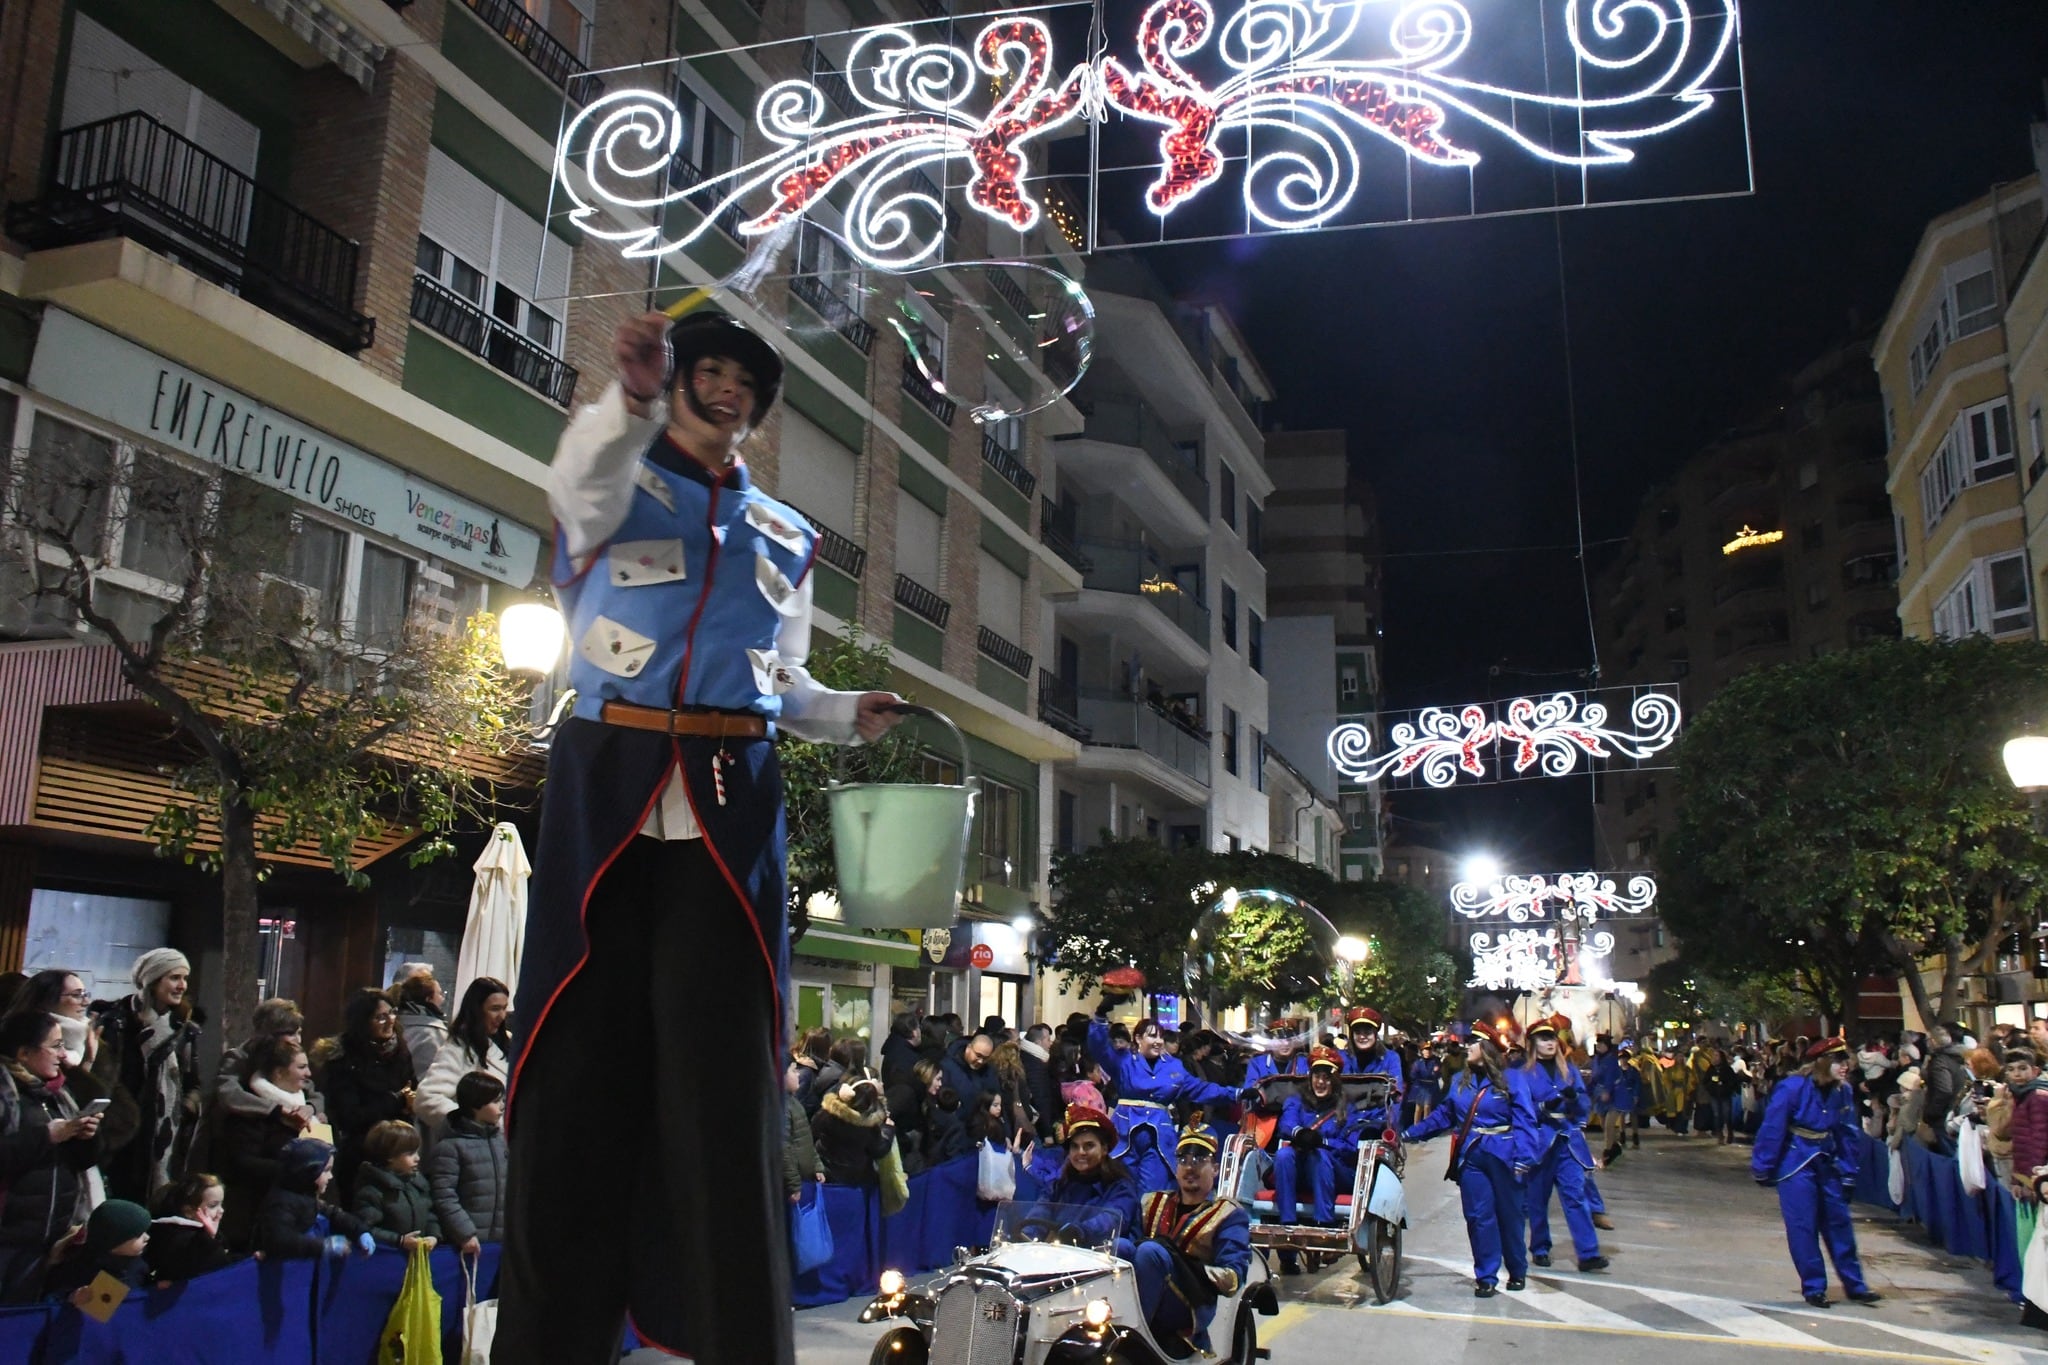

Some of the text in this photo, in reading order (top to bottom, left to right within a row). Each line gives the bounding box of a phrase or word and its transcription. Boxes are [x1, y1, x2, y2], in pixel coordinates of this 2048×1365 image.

[150, 370, 377, 526] ENTRESUELO SHOES
[407, 490, 490, 544] Venezianas
[973, 948, 992, 959] ria
